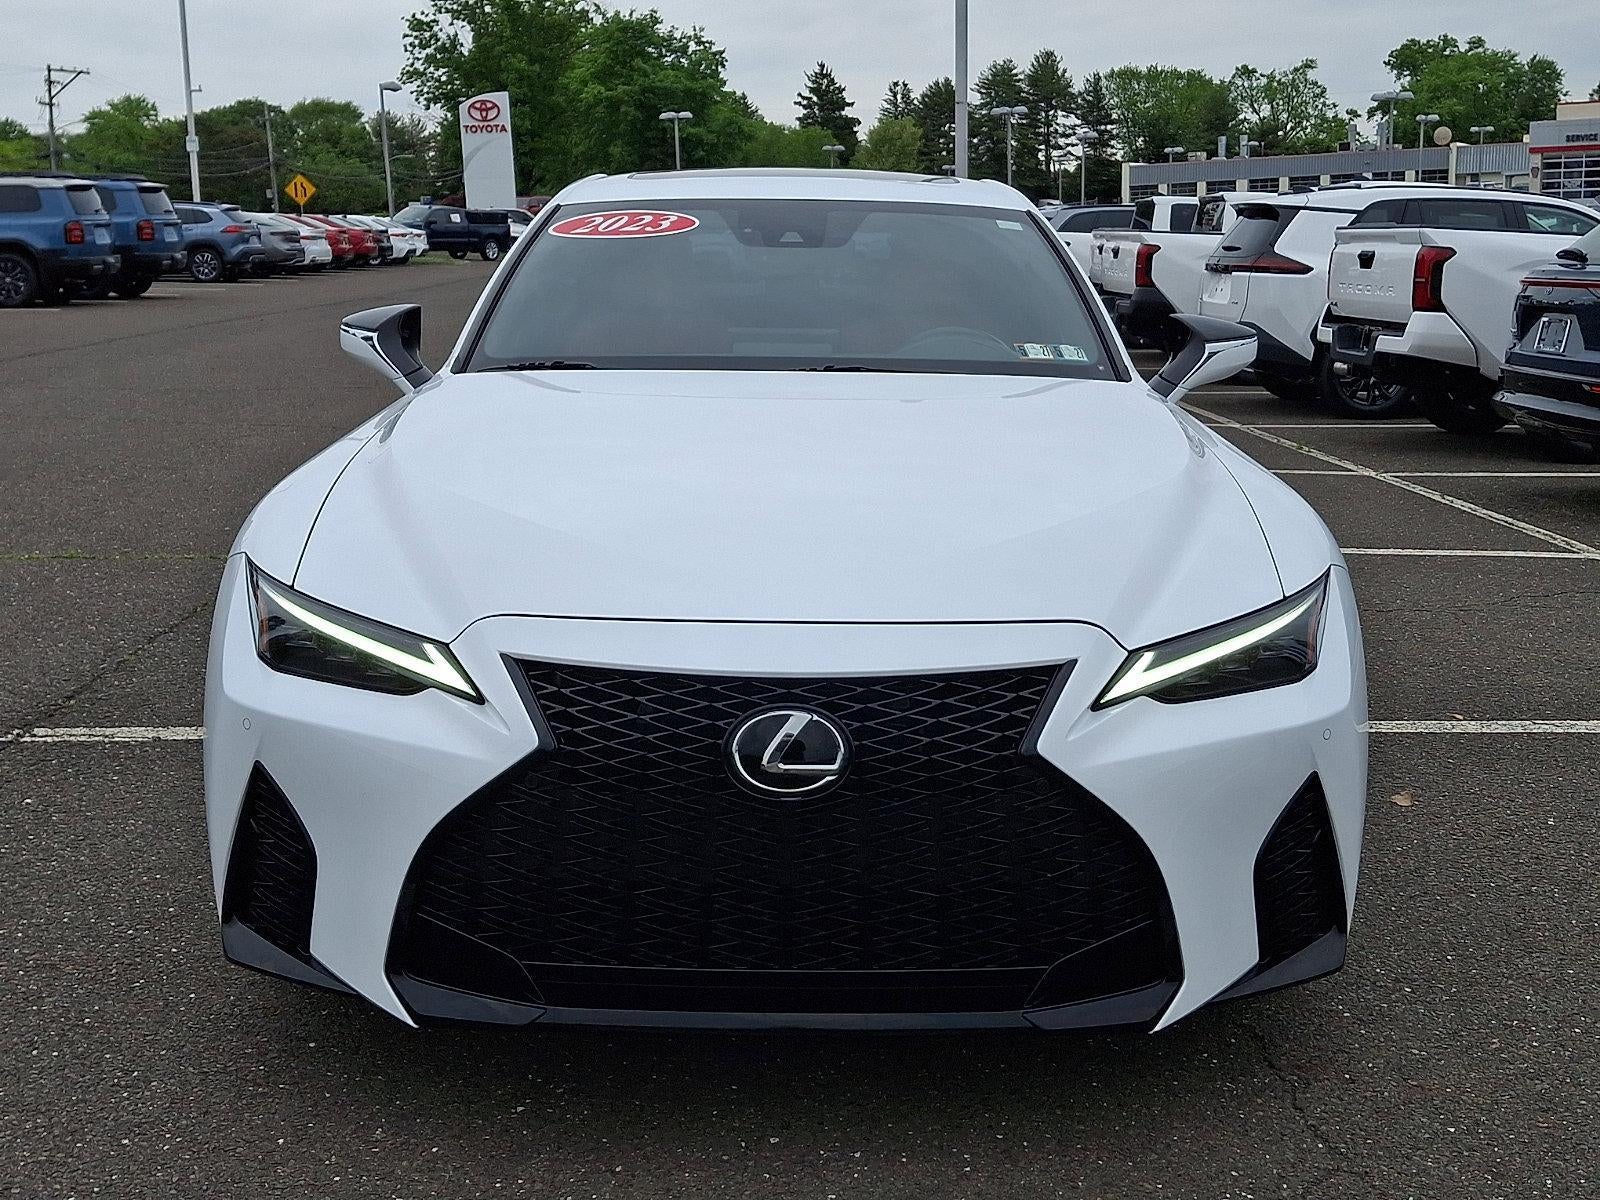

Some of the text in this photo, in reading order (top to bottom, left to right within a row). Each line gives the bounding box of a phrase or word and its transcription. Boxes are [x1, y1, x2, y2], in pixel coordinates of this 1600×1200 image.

[462, 124, 508, 134] TOYOTA
[1565, 133, 1598, 142] SERVICE
[569, 215, 678, 233] 2023
[1339, 282, 1396, 296] TACOMA
